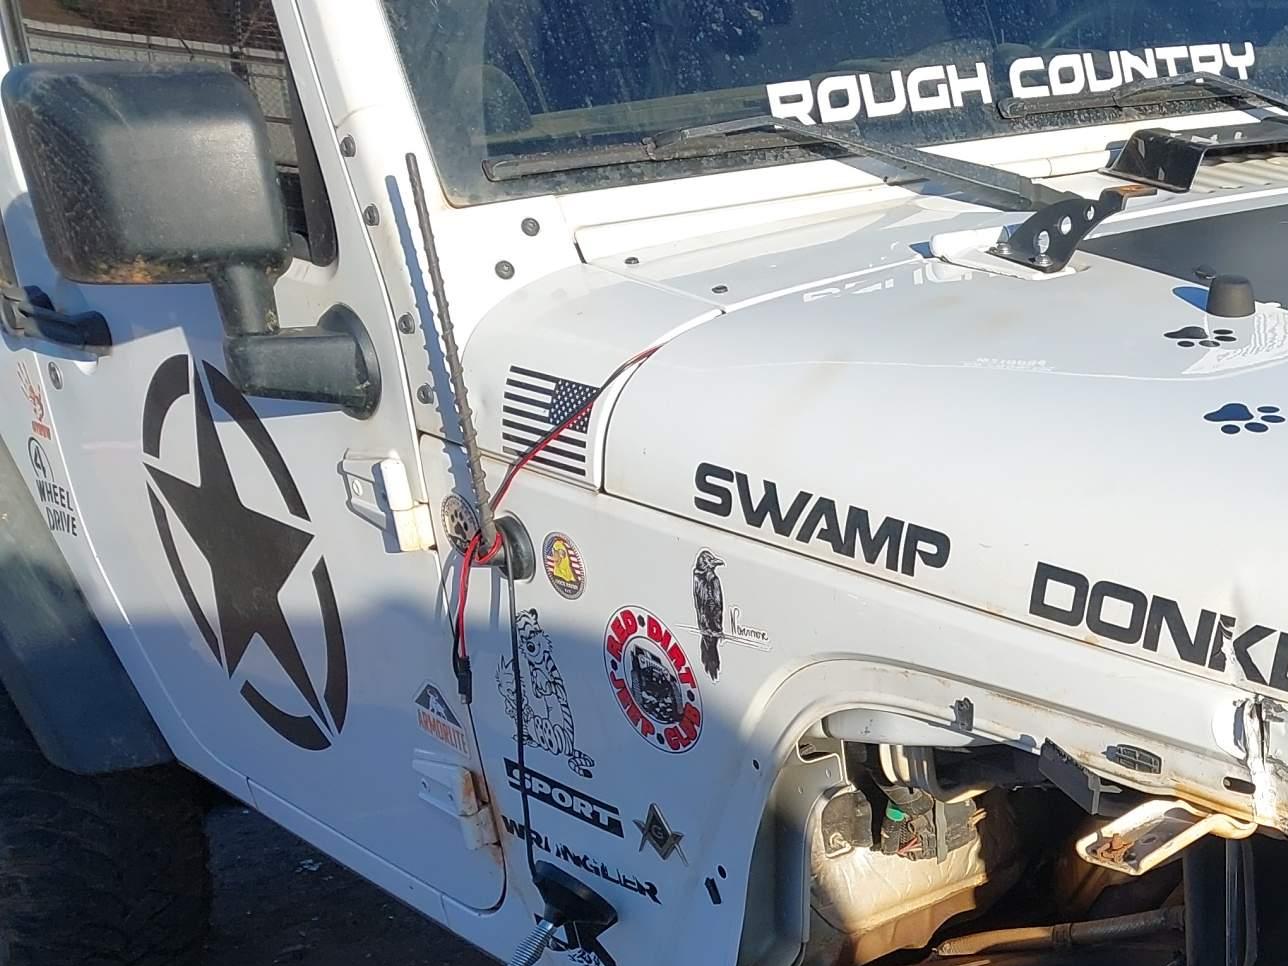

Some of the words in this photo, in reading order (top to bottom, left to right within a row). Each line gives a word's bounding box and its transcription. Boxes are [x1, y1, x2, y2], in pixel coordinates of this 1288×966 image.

[767, 61, 992, 125] ROUGH
[1008, 41, 1255, 98] COUNTRY
[33, 445, 47, 478] 4
[36, 479, 74, 512] WHEEL
[46, 507, 78, 537] DRIVE
[693, 462, 951, 576] SWAMP
[606, 609, 638, 663] RED
[646, 614, 697, 689] DIRT
[610, 671, 656, 738] JEEP
[663, 702, 701, 751] CLUB
[508, 766, 622, 825] SPORT
